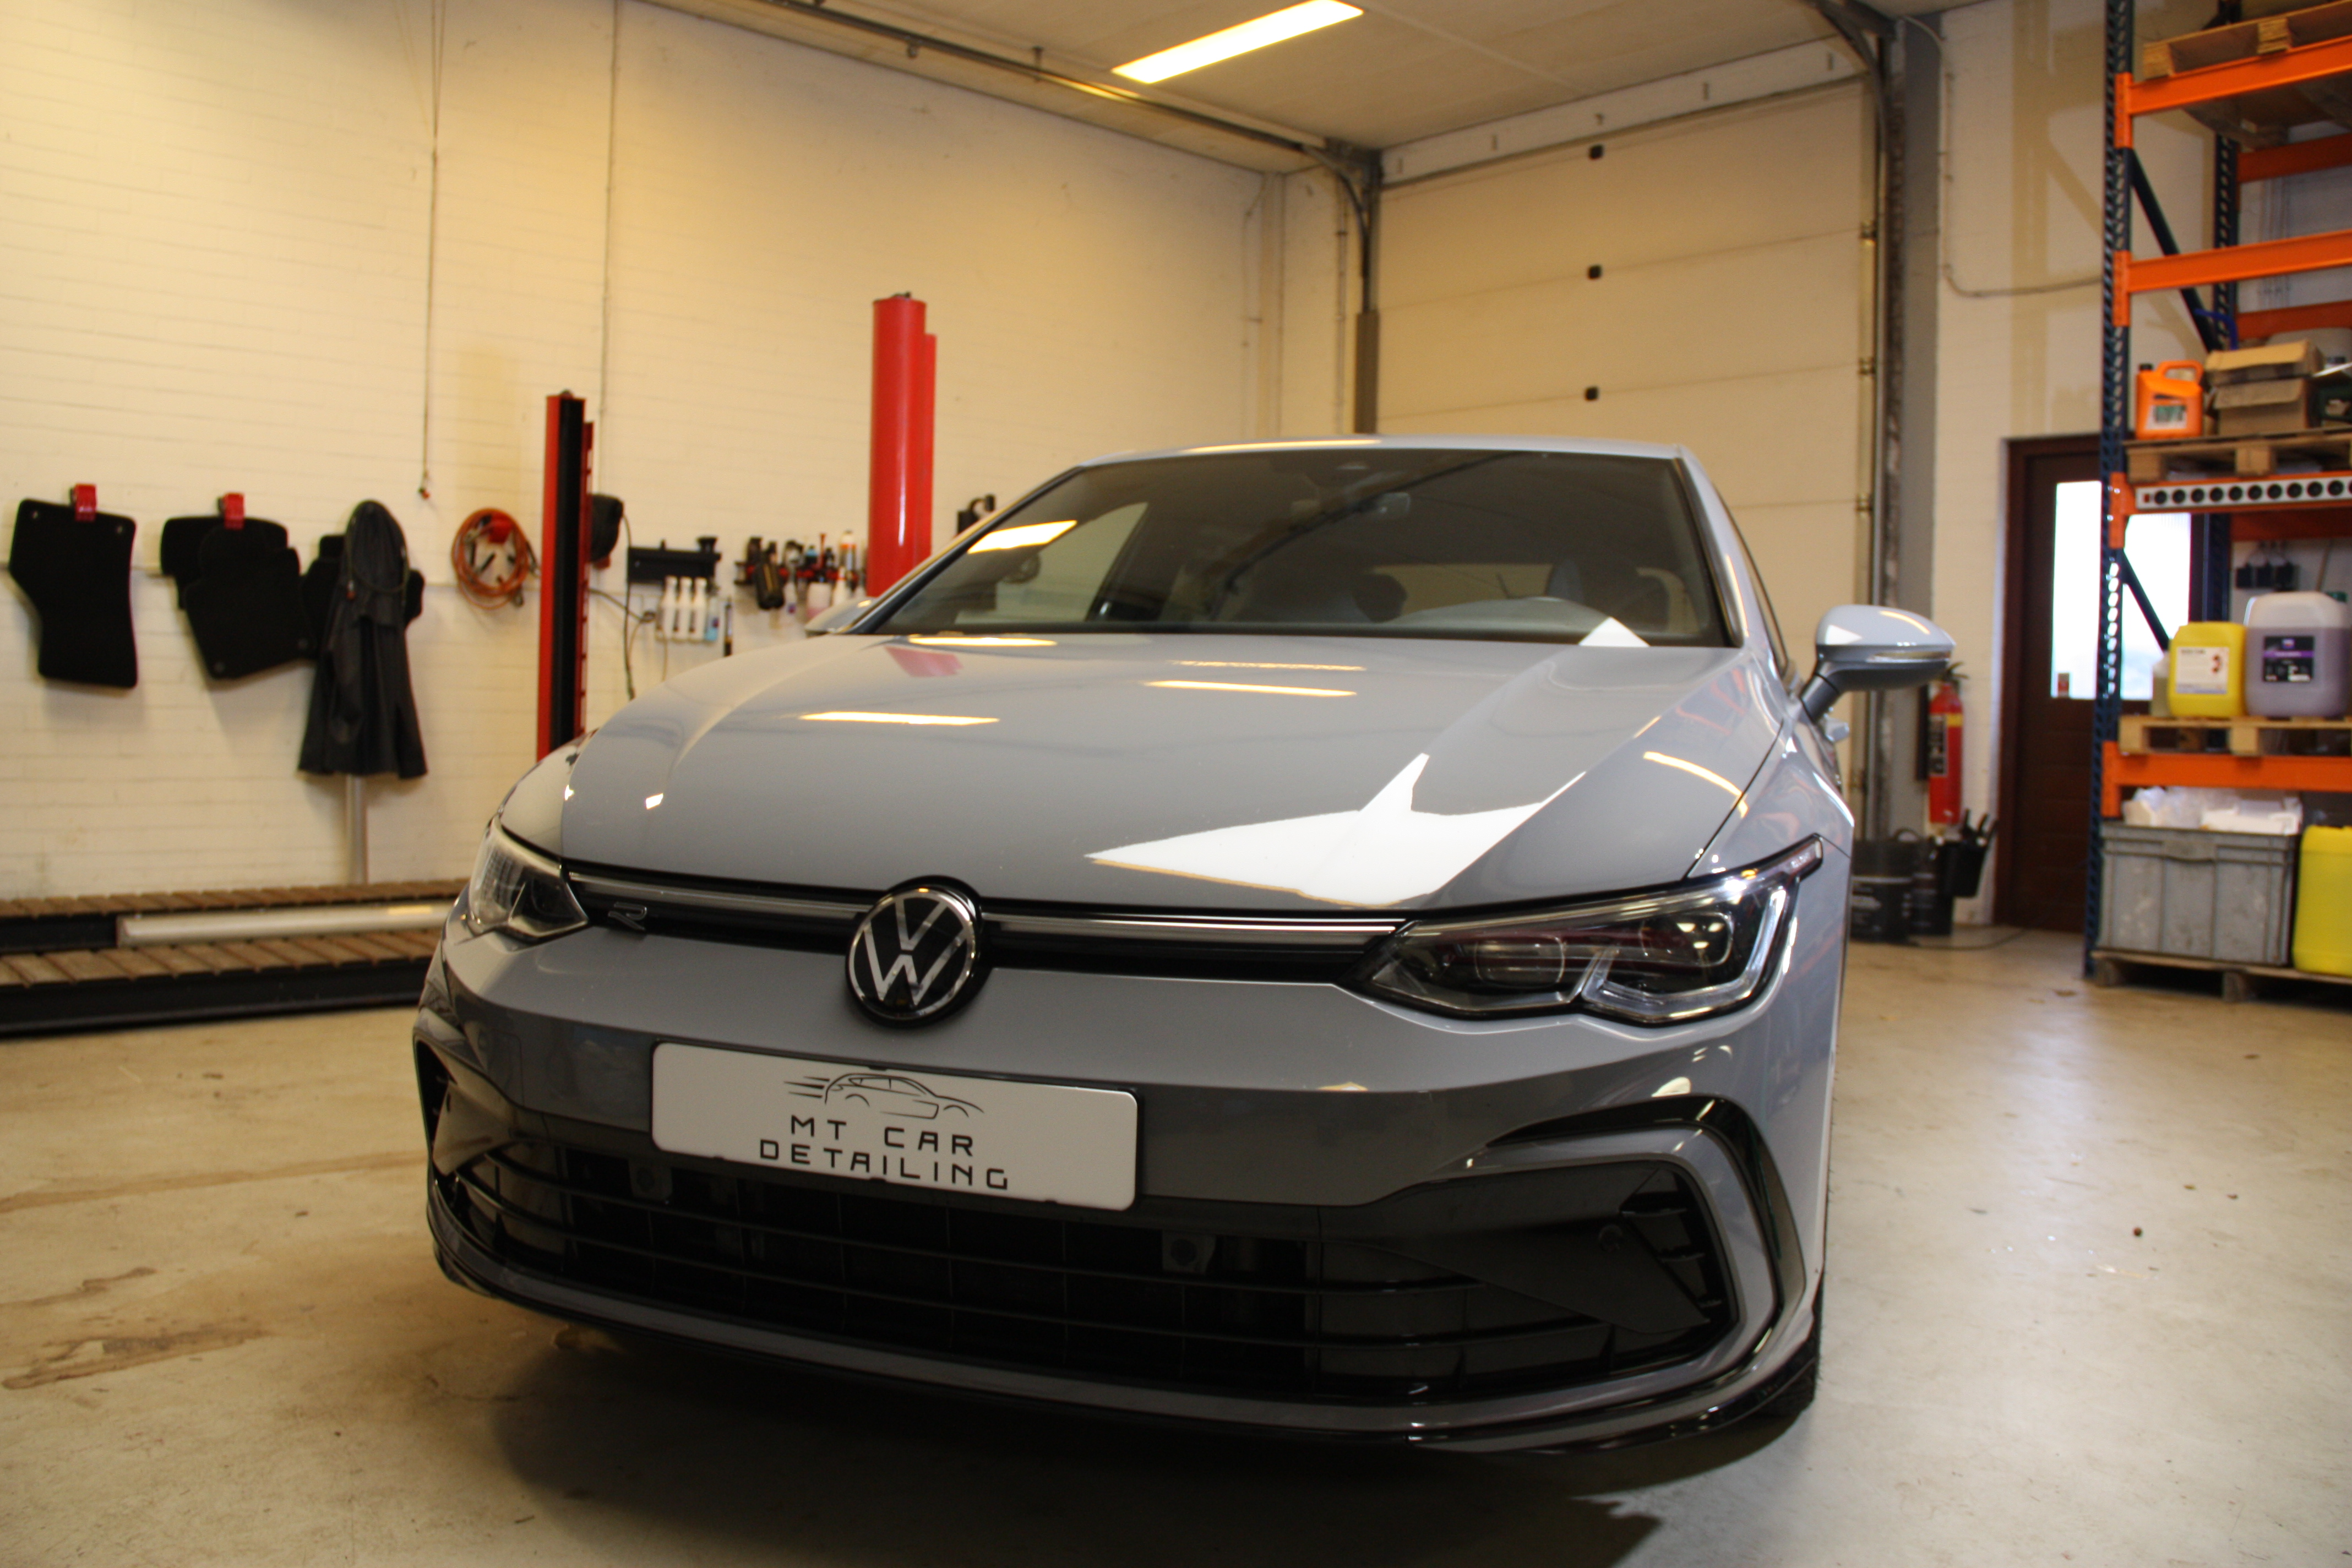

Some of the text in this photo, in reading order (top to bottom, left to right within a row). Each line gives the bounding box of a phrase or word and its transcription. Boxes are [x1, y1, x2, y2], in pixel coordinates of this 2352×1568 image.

[791, 1114, 973, 1157] MT CAR
[760, 1138, 1008, 1190] DETAILING
